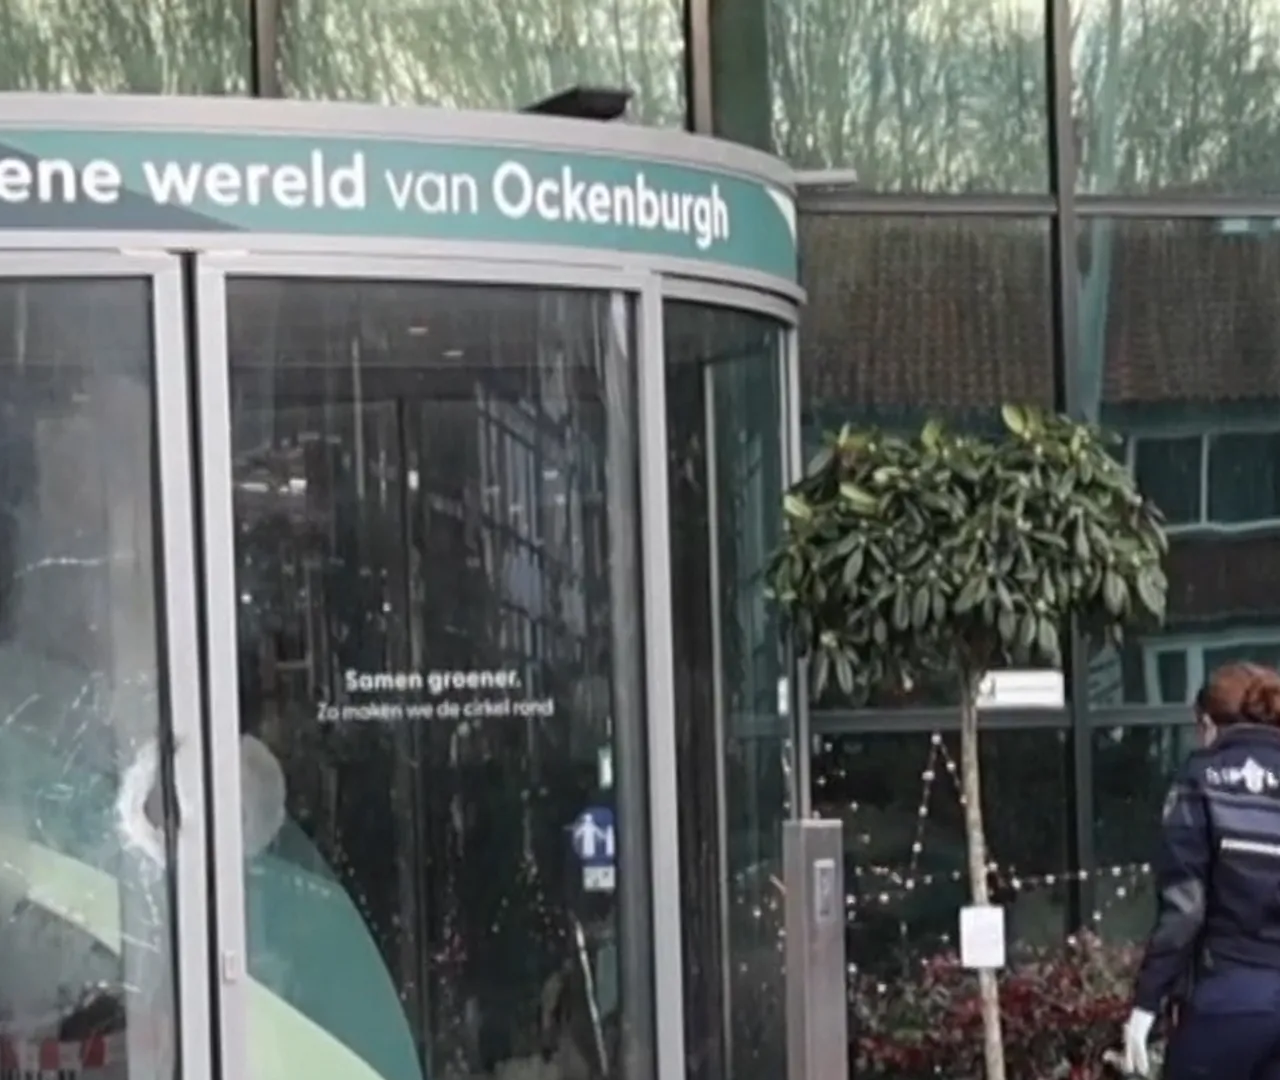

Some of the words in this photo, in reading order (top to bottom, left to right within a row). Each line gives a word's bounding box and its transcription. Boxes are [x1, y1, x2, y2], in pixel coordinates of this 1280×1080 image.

[142, 149, 366, 211] wereld
[383, 166, 479, 215] van
[492, 160, 730, 249] Ockenburgh
[344, 669, 423, 692] Samen
[317, 702, 339, 721] Zo
[342, 700, 404, 721] maken
[407, 703, 433, 719] we
[437, 700, 460, 719] de
[463, 699, 510, 718] cirkel
[512, 698, 555, 718] rond
